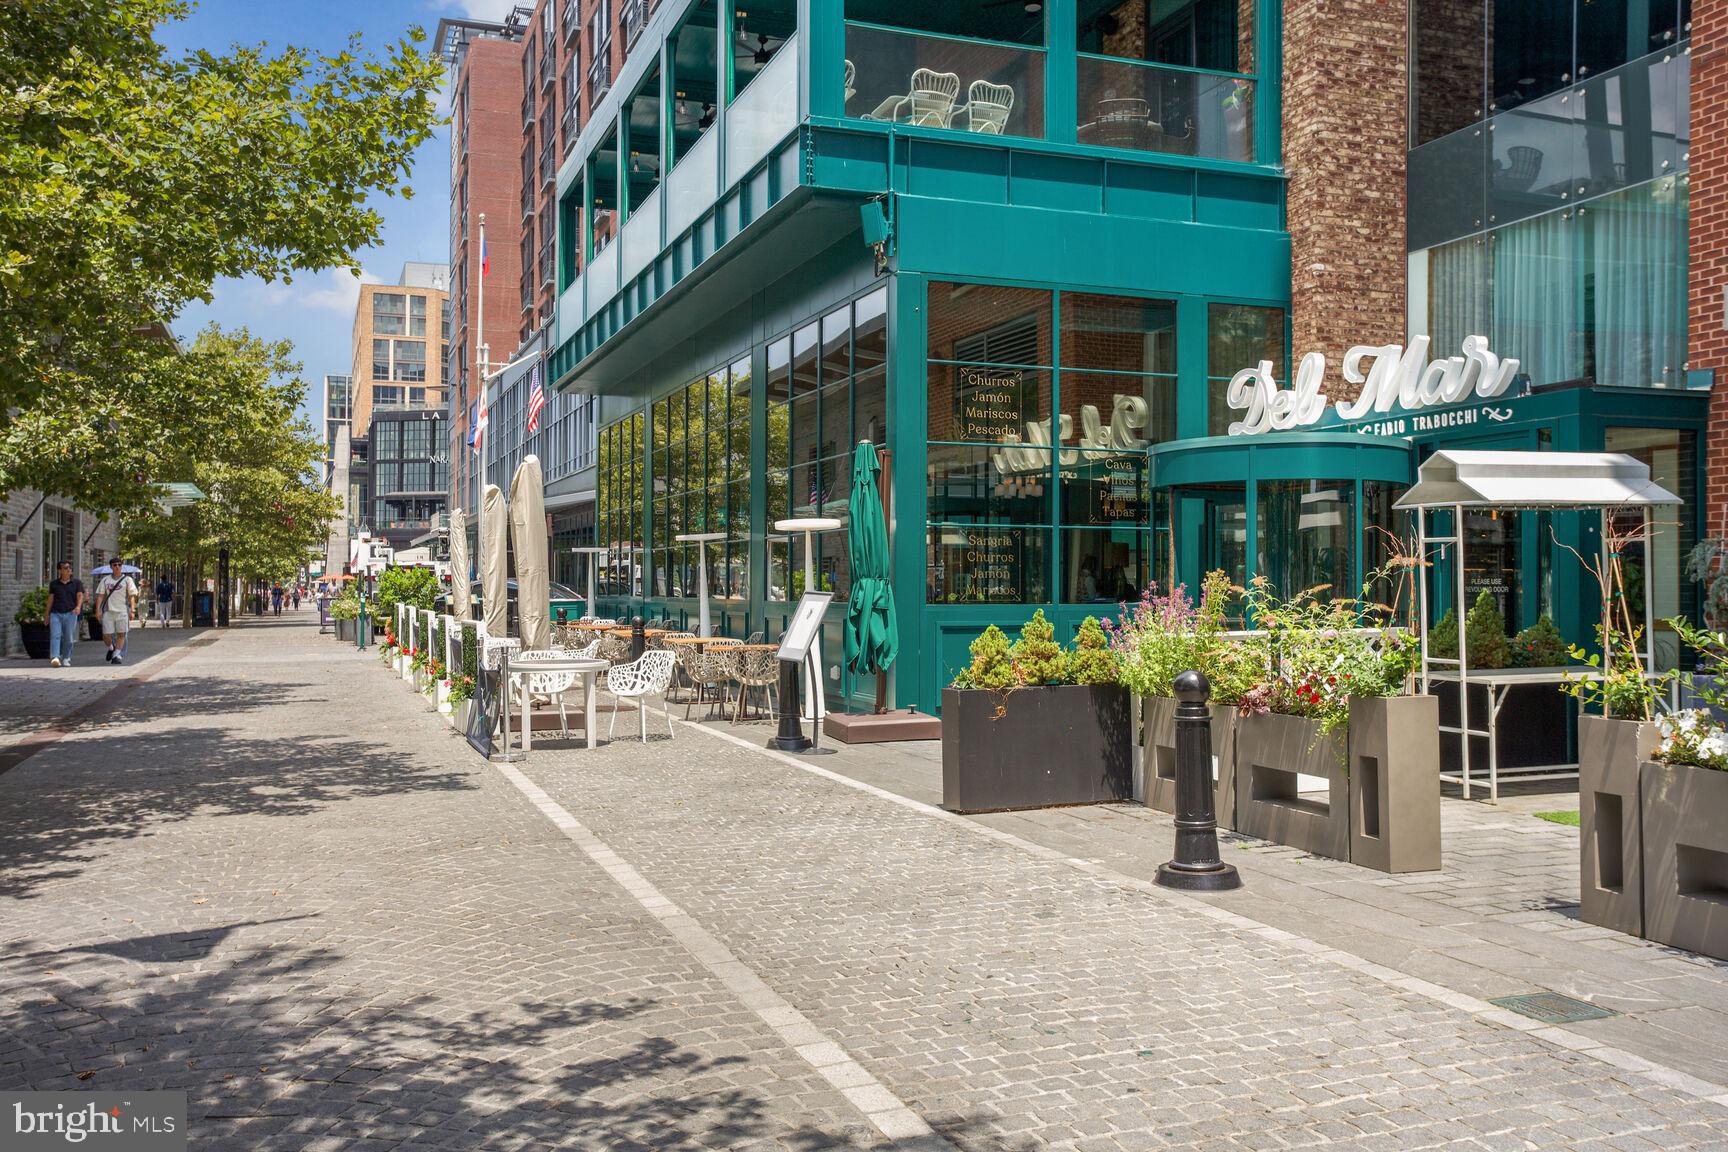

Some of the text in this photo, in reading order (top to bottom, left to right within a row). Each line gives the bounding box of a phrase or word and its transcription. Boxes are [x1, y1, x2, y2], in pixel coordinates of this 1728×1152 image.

[968, 374, 1015, 387] Churros
[1227, 334, 1520, 436] Del Mar
[972, 391, 1011, 403] Jamón
[965, 406, 1018, 420] Mariscos
[1374, 409, 1478, 436] FABIO TRABOCCHI
[968, 423, 1016, 436] Pescado
[1105, 458, 1133, 470] Cava
[1103, 474, 1135, 486] Vinos
[1102, 505, 1135, 519] Tapas
[967, 550, 1015, 563] Churros
[971, 567, 1010, 579] Jamón
